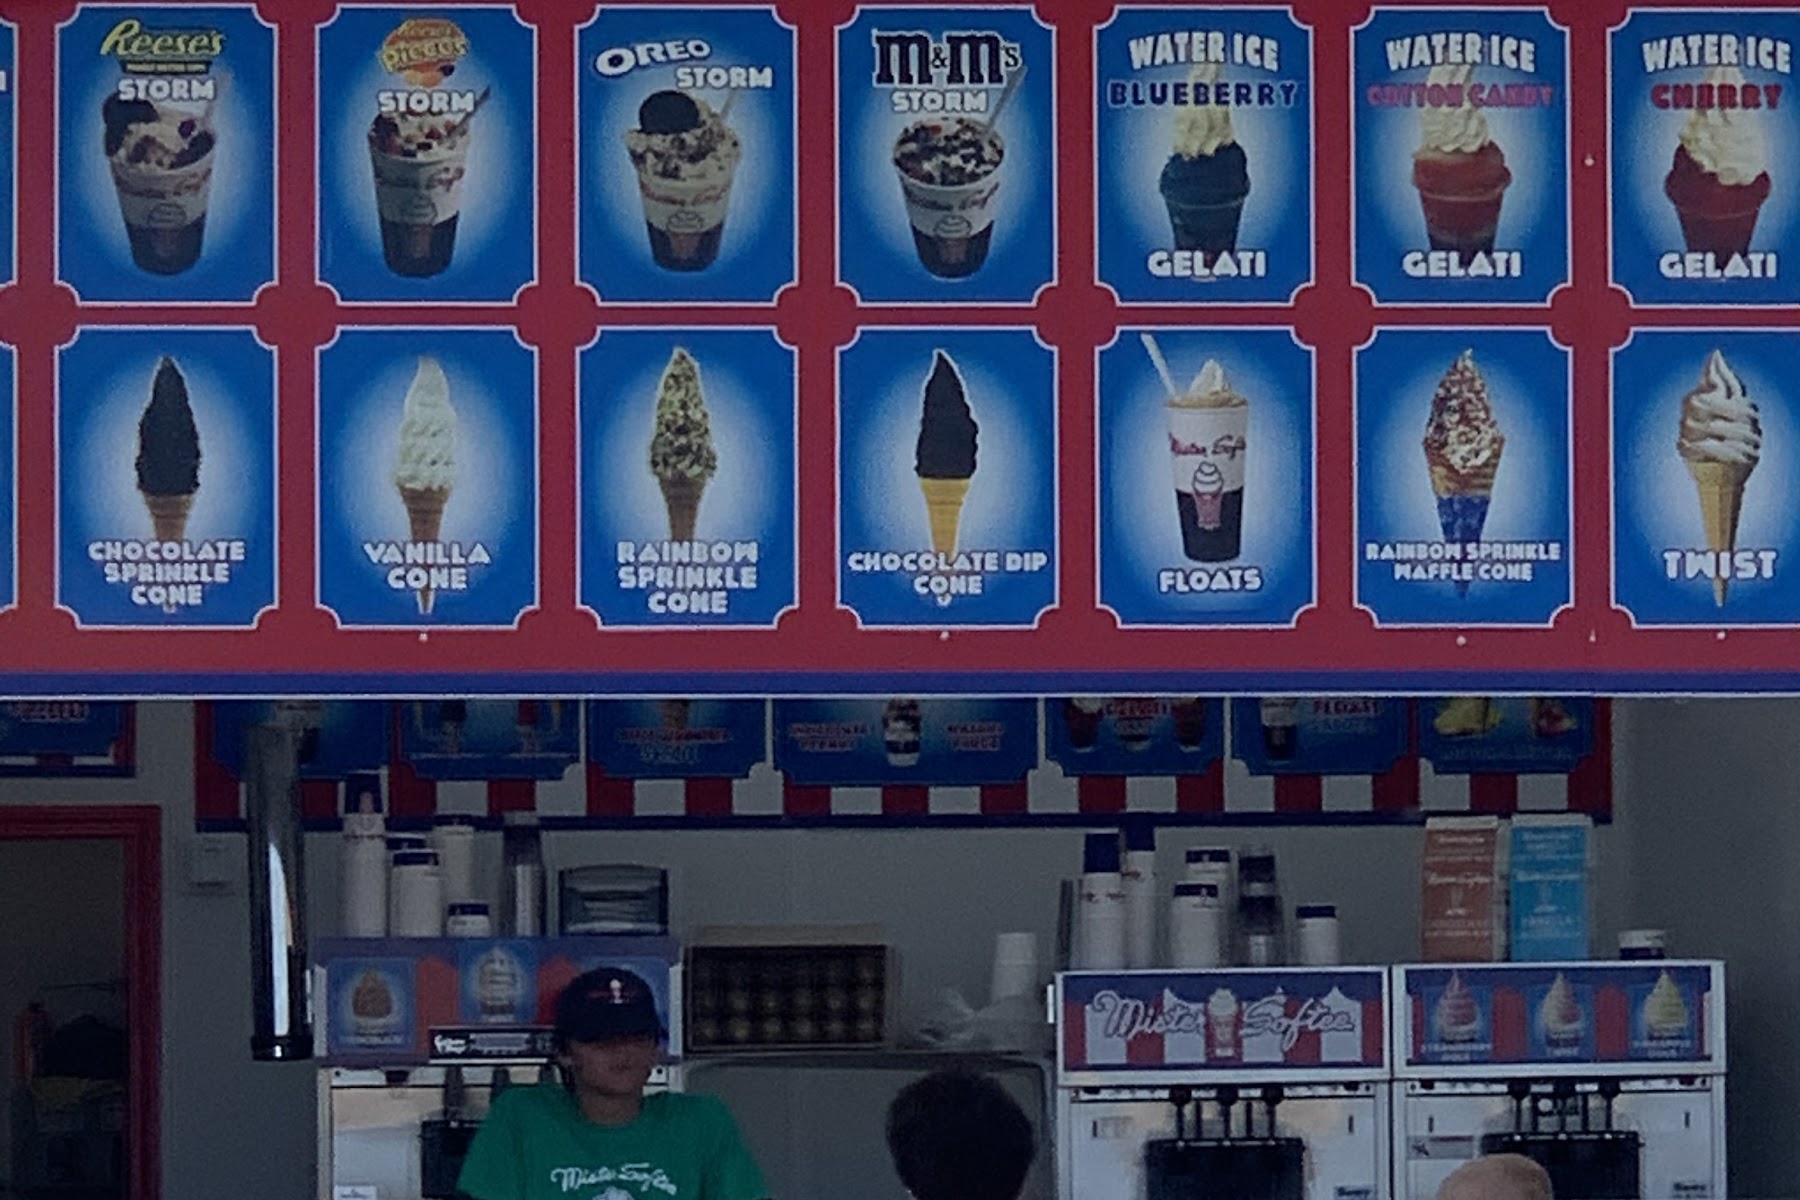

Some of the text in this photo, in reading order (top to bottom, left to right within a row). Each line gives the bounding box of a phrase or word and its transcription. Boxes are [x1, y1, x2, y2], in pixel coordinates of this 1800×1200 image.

[100, 19, 226, 56] Reese's
[596, 39, 711, 79] OREO
[1129, 31, 1279, 72] WATER ICE
[1386, 31, 1535, 72] WATER ICE
[1642, 32, 1792, 73] WATER ICE
[118, 78, 216, 101] STORM
[675, 65, 772, 90] STORM
[378, 90, 475, 113] STORM
[892, 90, 987, 113] STORM
[1108, 82, 1298, 108] BLUEBERRY
[1651, 83, 1783, 110] CHERRY
[1147, 250, 1266, 278] GELATI
[1402, 250, 1521, 278] GELATI
[1659, 250, 1778, 279] GELATI
[88, 541, 245, 562] CHOCOLATE
[364, 542, 491, 565] VANILLA
[617, 541, 759, 565] RAINBOW
[847, 552, 1048, 573] CHOCOLATE DIP
[1365, 542, 1561, 562] RAINBOW SPRINKLE
[1663, 549, 1778, 579] TWIST
[104, 562, 230, 583] SPRINKLE
[387, 567, 468, 590] CONE
[618, 565, 758, 590] SPRINKLE
[1158, 567, 1263, 594] FLOATS
[1394, 562, 1533, 582] WAFFLE CONE
[131, 584, 203, 605] CONE
[913, 574, 982, 596] CONE
[648, 591, 729, 615] CONE
[1092, 990, 1355, 1051] Mister Softee
